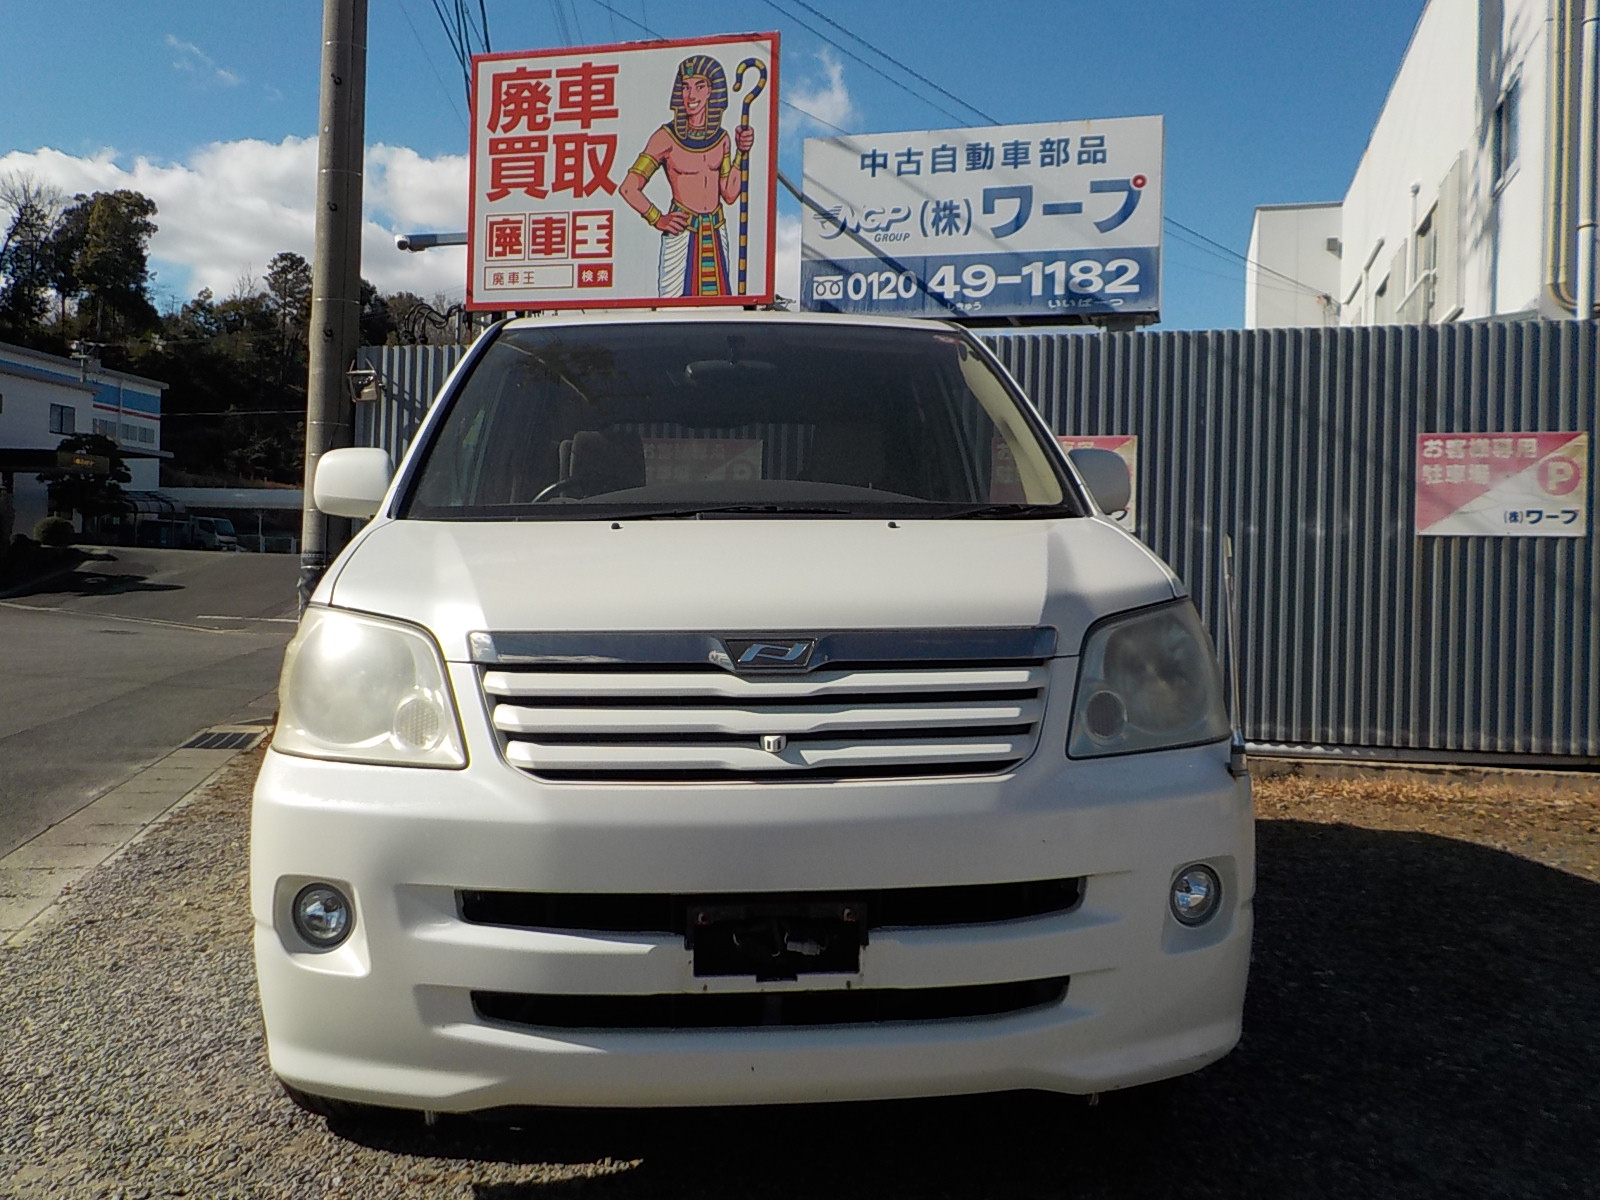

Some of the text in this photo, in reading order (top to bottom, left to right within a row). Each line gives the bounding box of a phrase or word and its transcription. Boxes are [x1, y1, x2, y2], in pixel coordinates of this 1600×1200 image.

[487, 62, 619, 133] 廃車
[486, 133, 618, 202] 買取
[860, 135, 1107, 177] 中古自動車部品
[874, 233, 911, 243] GROUP
[492, 269, 609, 285] 廃車王 検索
[847, 258, 1140, 300] 0120 49-1182
[1547, 461, 1574, 490] P
